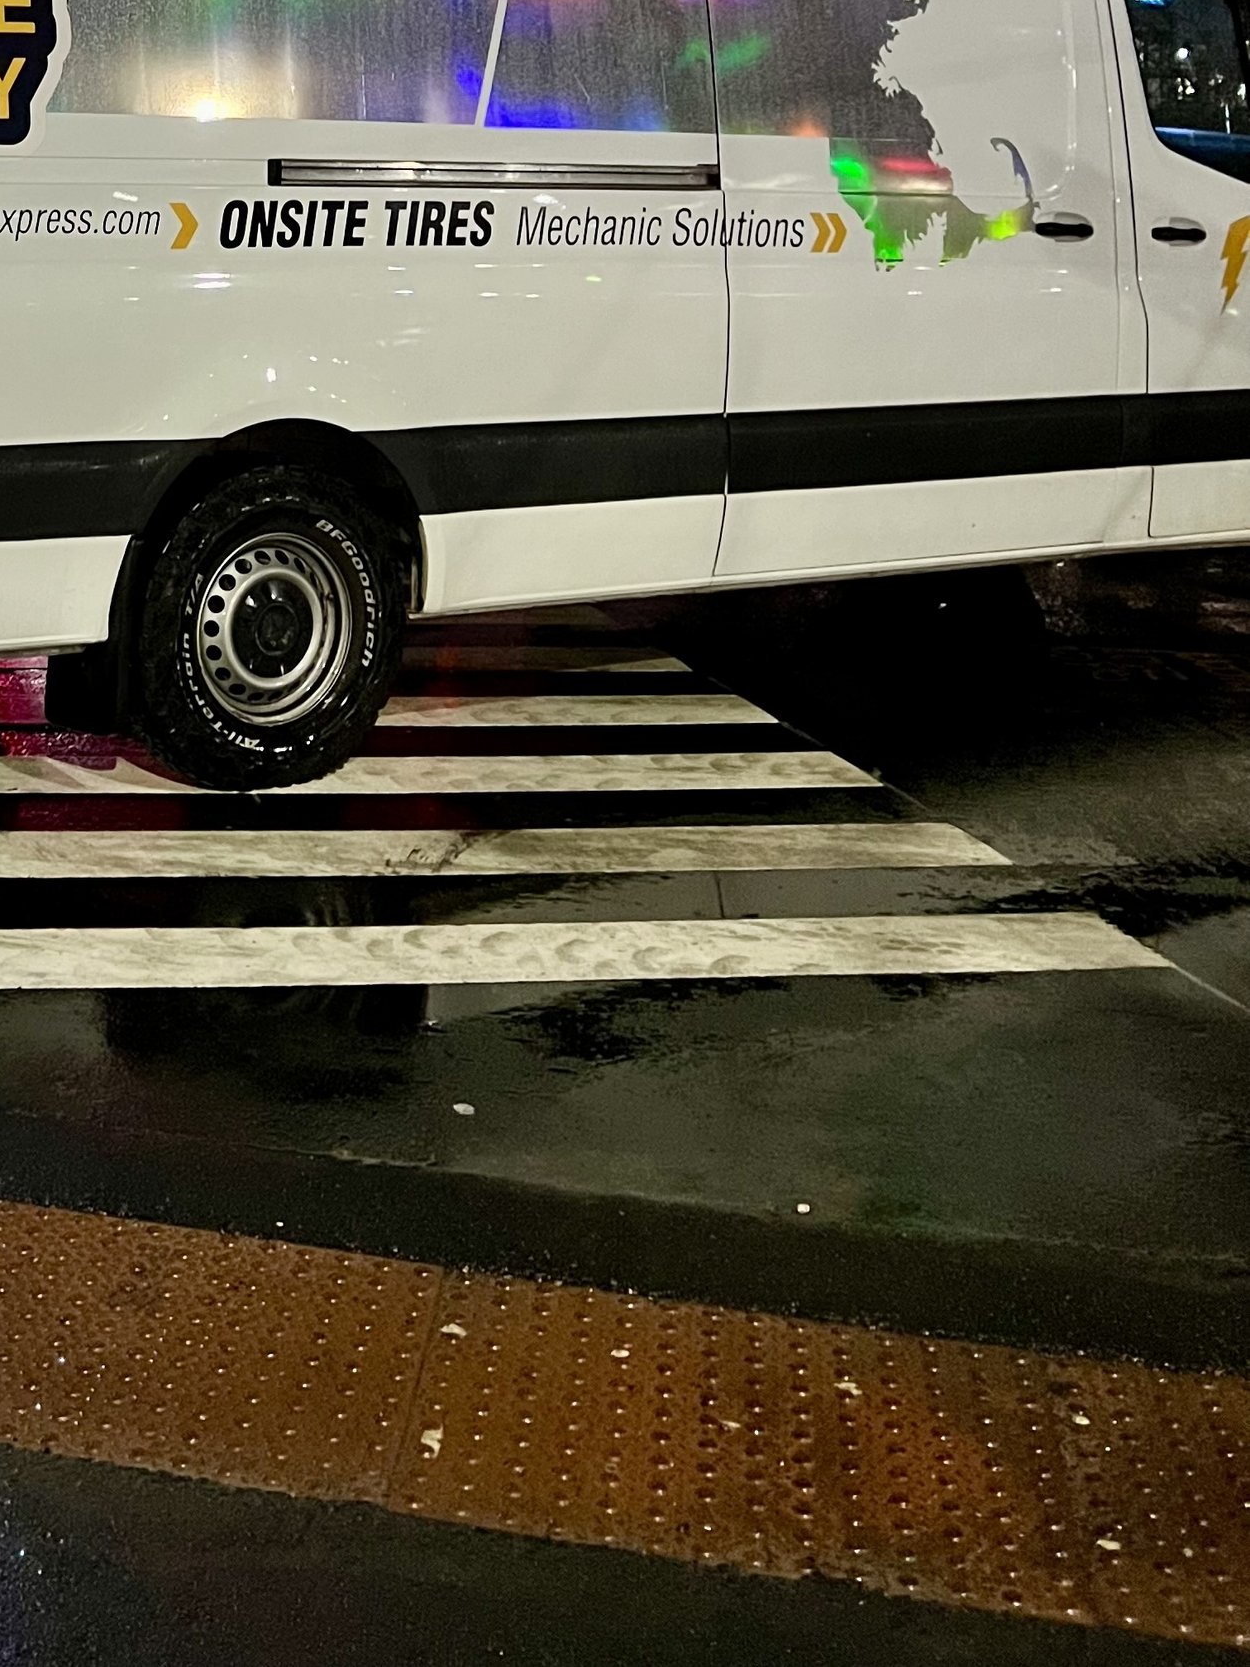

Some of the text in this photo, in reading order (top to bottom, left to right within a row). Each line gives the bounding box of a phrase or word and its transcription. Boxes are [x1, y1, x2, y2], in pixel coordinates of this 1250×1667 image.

[219, 199, 369, 249] ONSITE
[384, 200, 495, 247] TIRES
[516, 206, 662, 246] Mechanic
[672, 207, 805, 247] Solutions
[316, 519, 376, 667] BFGoodrich
[182, 633, 261, 748] All-Terrain
